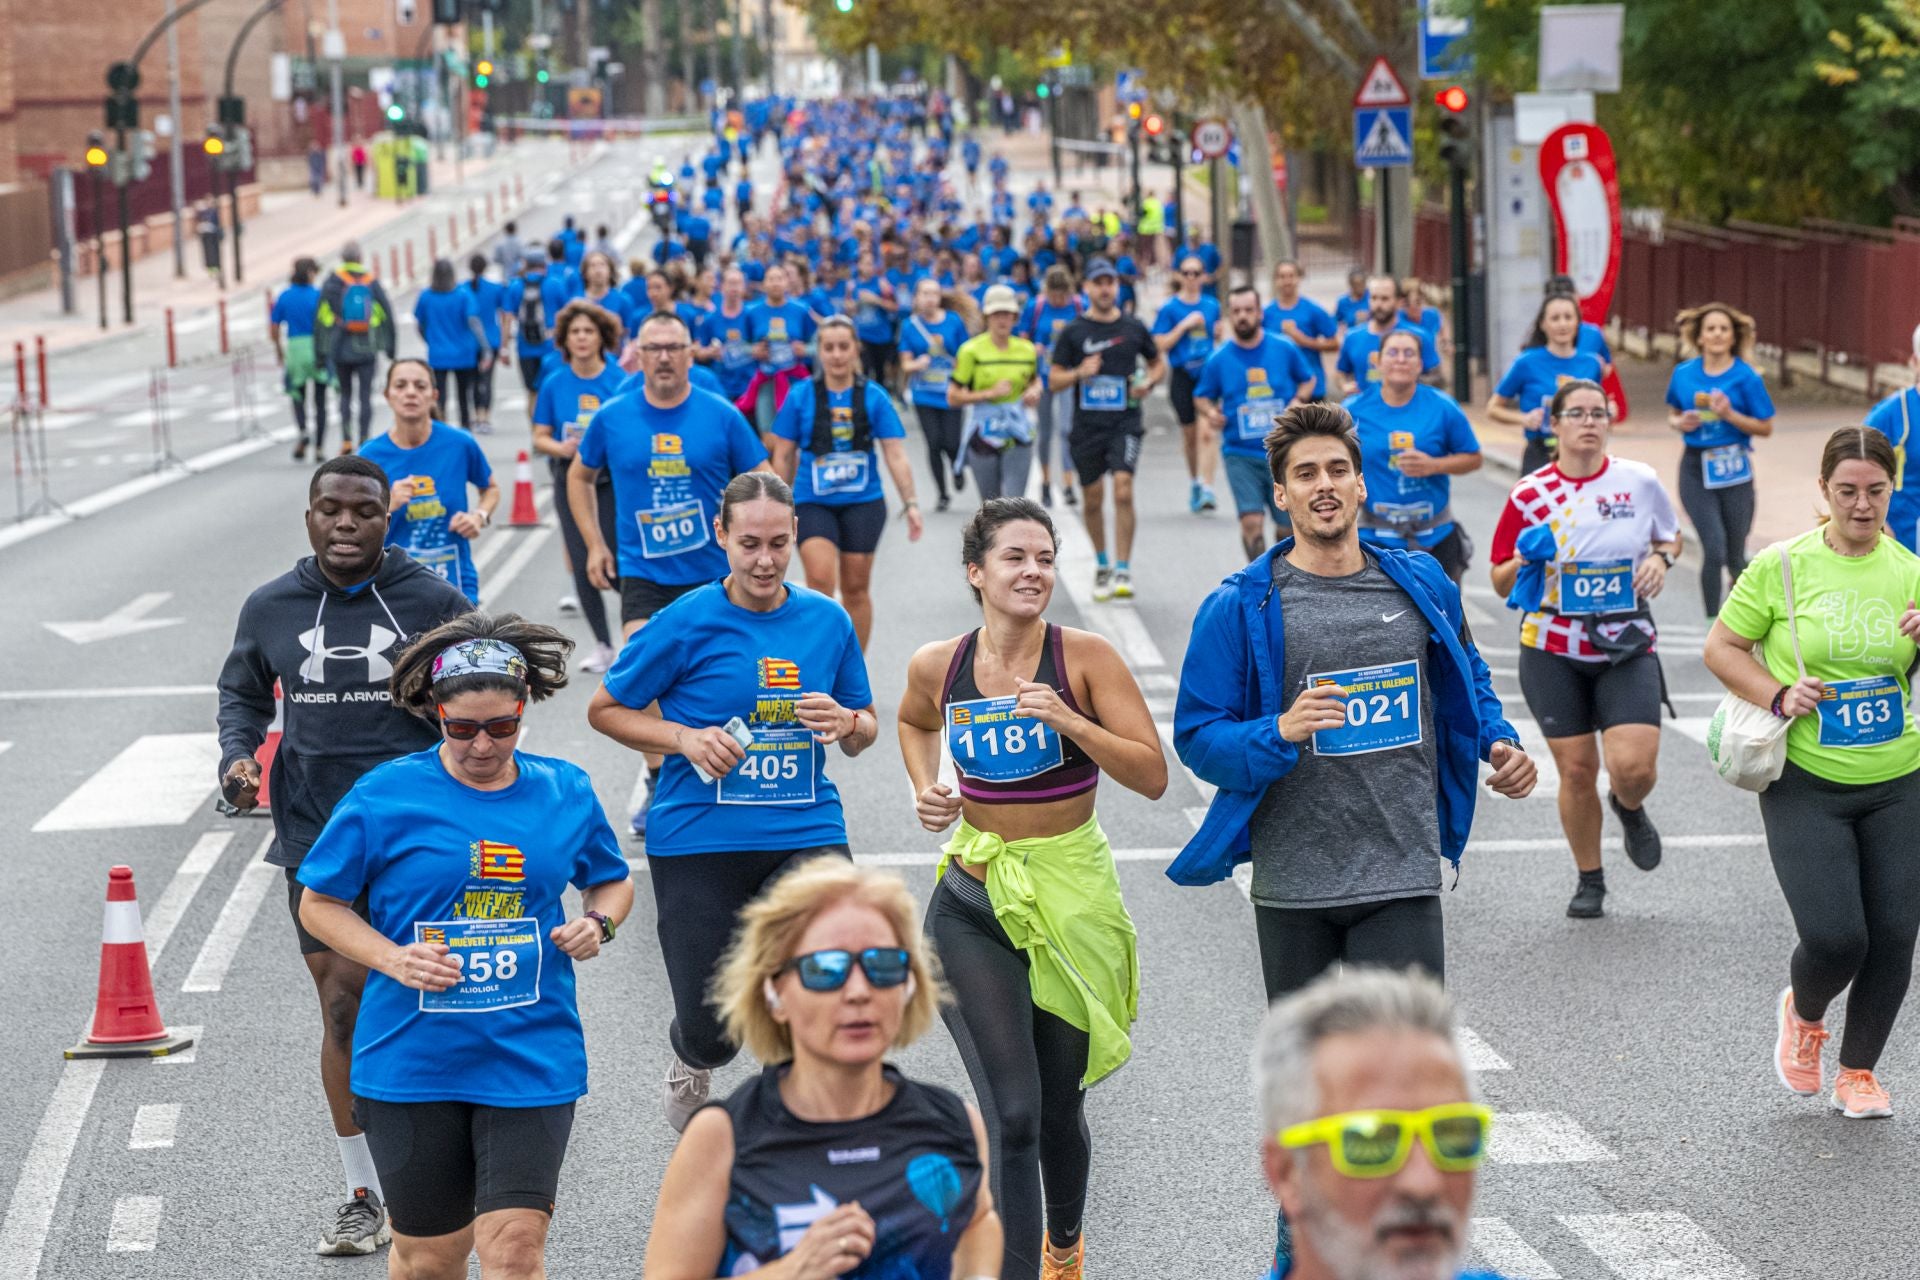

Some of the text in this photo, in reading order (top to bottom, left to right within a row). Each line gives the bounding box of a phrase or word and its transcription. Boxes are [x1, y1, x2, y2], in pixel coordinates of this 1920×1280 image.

[652, 518, 695, 542] 010
[1574, 576, 1622, 598] 024
[1375, 680, 1381, 690] X
[1381, 676, 1415, 689] VALENCIA
[290, 691, 394, 703] UNDER ARMO
[749, 711, 756, 723] X
[974, 712, 1007, 724] MUÉVETE
[1836, 699, 1891, 727] 163
[958, 722, 1047, 758] 1181
[738, 754, 798, 780] 405
[449, 934, 535, 947] MUÉVETE X VALENCIA
[460, 984, 500, 994] ALIOLIOLE
